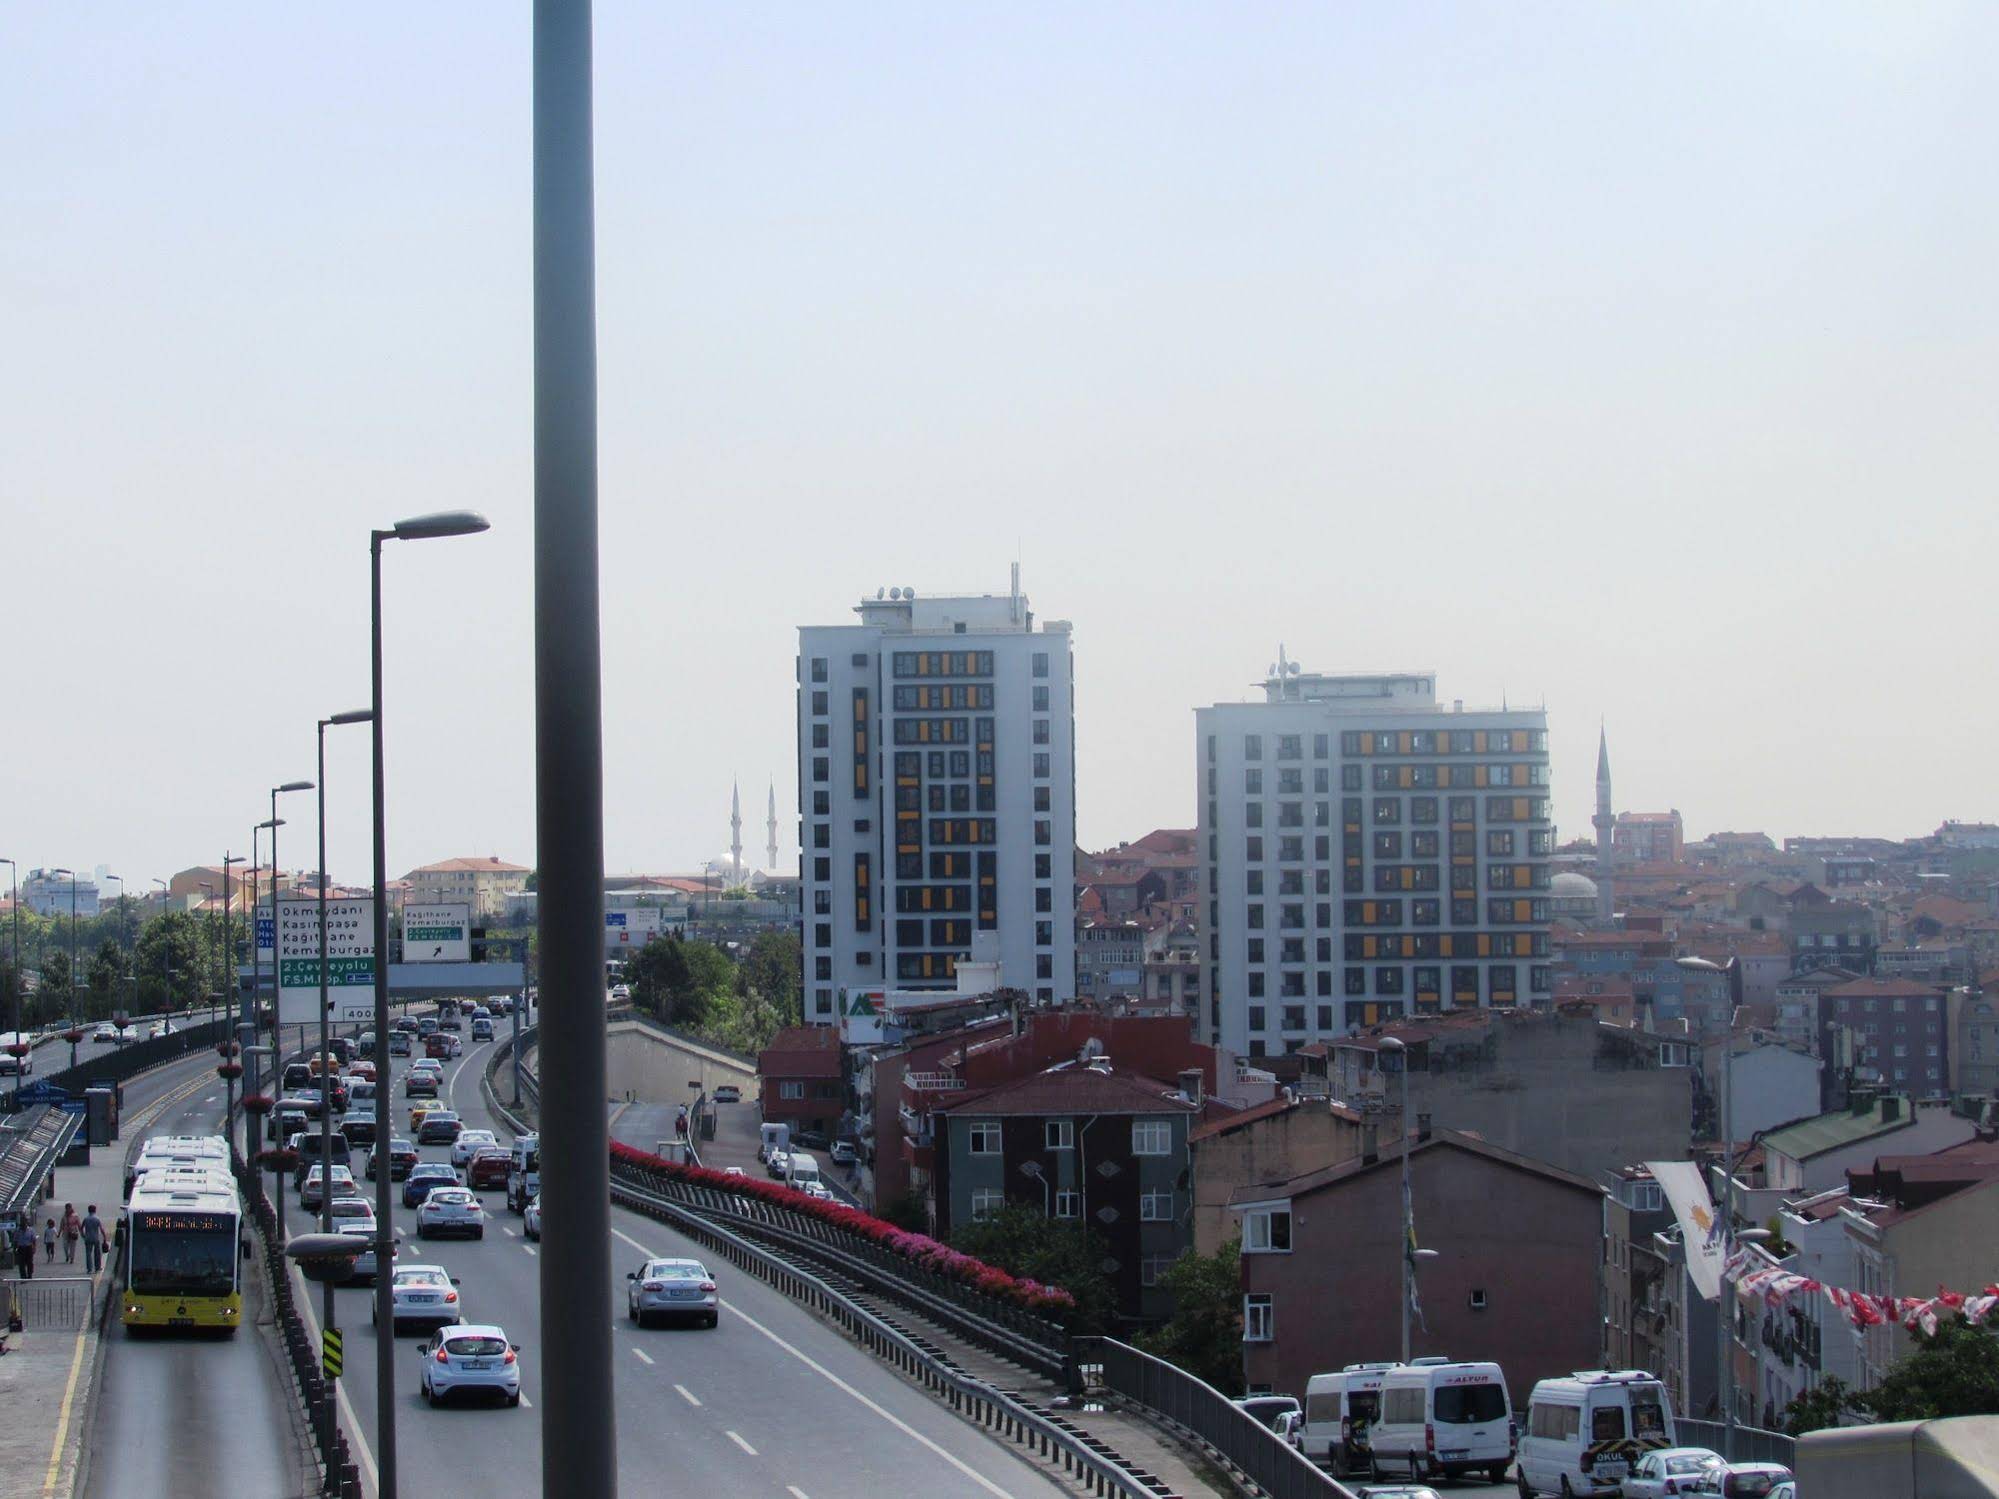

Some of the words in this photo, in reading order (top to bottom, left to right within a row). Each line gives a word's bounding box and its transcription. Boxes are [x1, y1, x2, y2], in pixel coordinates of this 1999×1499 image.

[283, 932, 355, 944] Kağıtane
[283, 945, 376, 956] Kemeburgaz
[284, 960, 368, 973] 2.Çeveyolu
[349, 1010, 375, 1018] 400
[1597, 1452, 1624, 1462] OKUL
